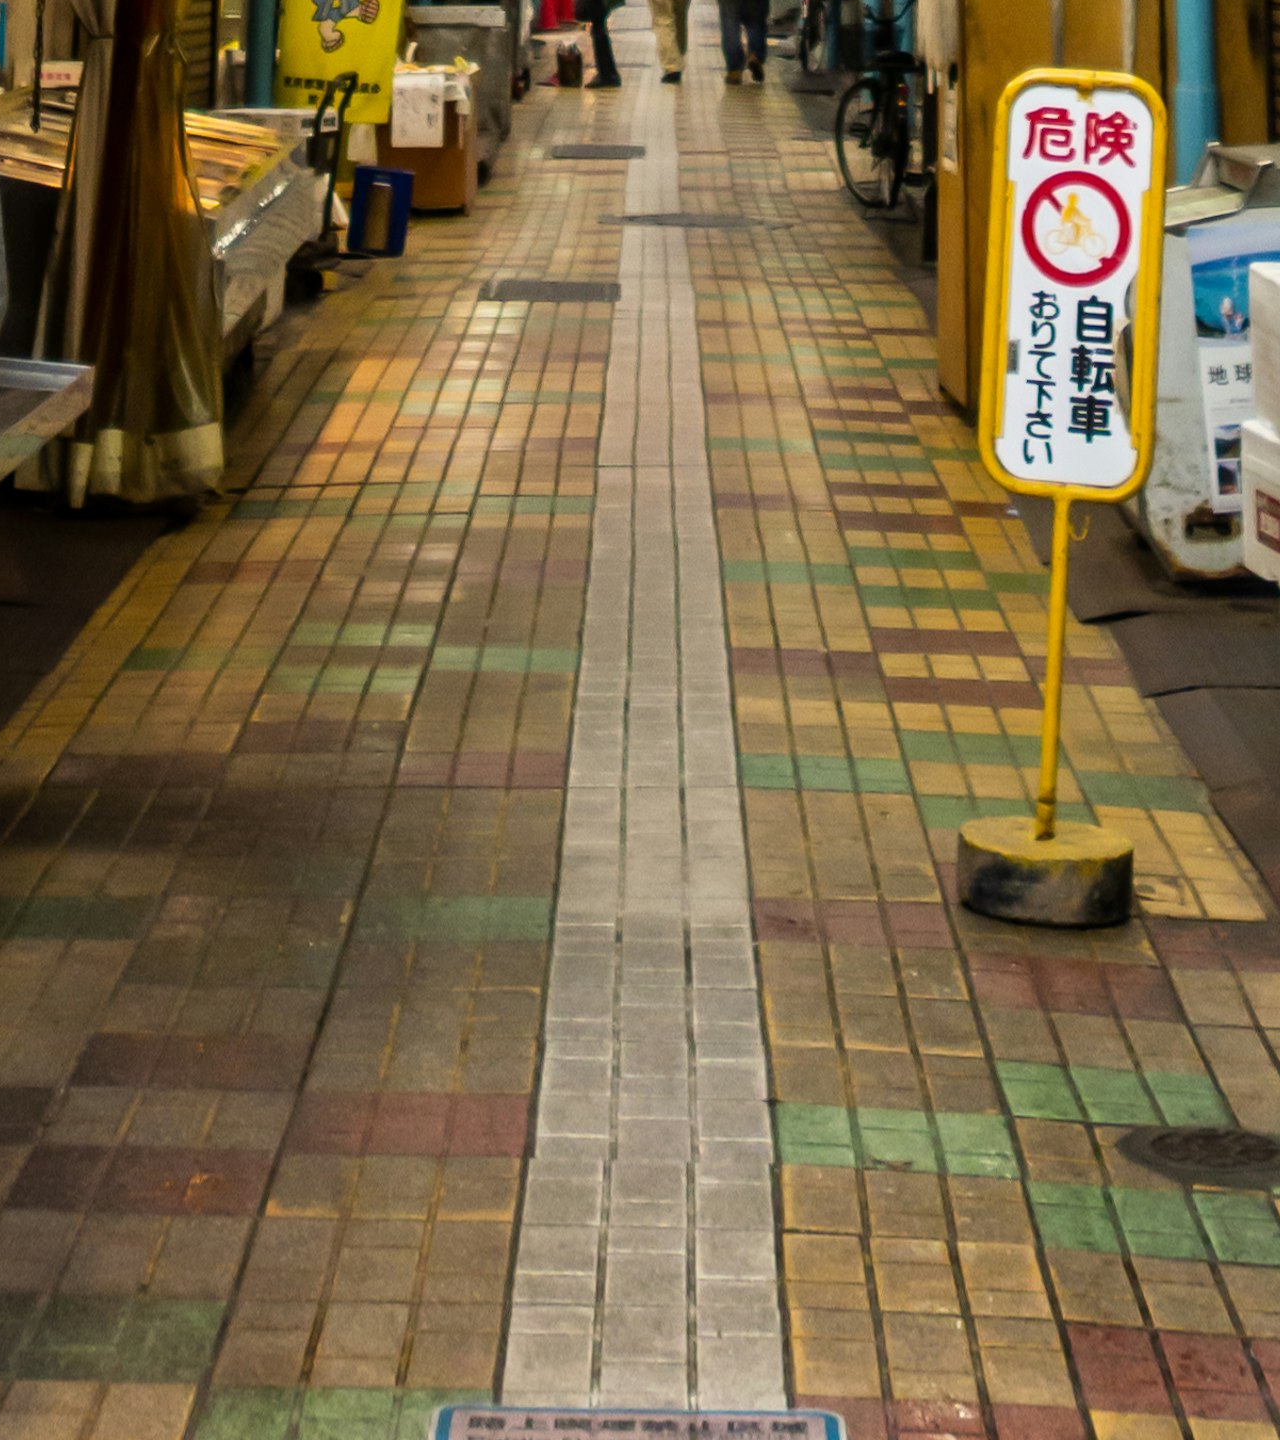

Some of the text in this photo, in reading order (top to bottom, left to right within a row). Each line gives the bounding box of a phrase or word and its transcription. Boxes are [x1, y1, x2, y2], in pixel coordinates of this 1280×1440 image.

[1023, 107, 1136, 168] 危険
[1022, 290, 1061, 465] おりて下さい
[1067, 294, 1116, 444] 自転車
